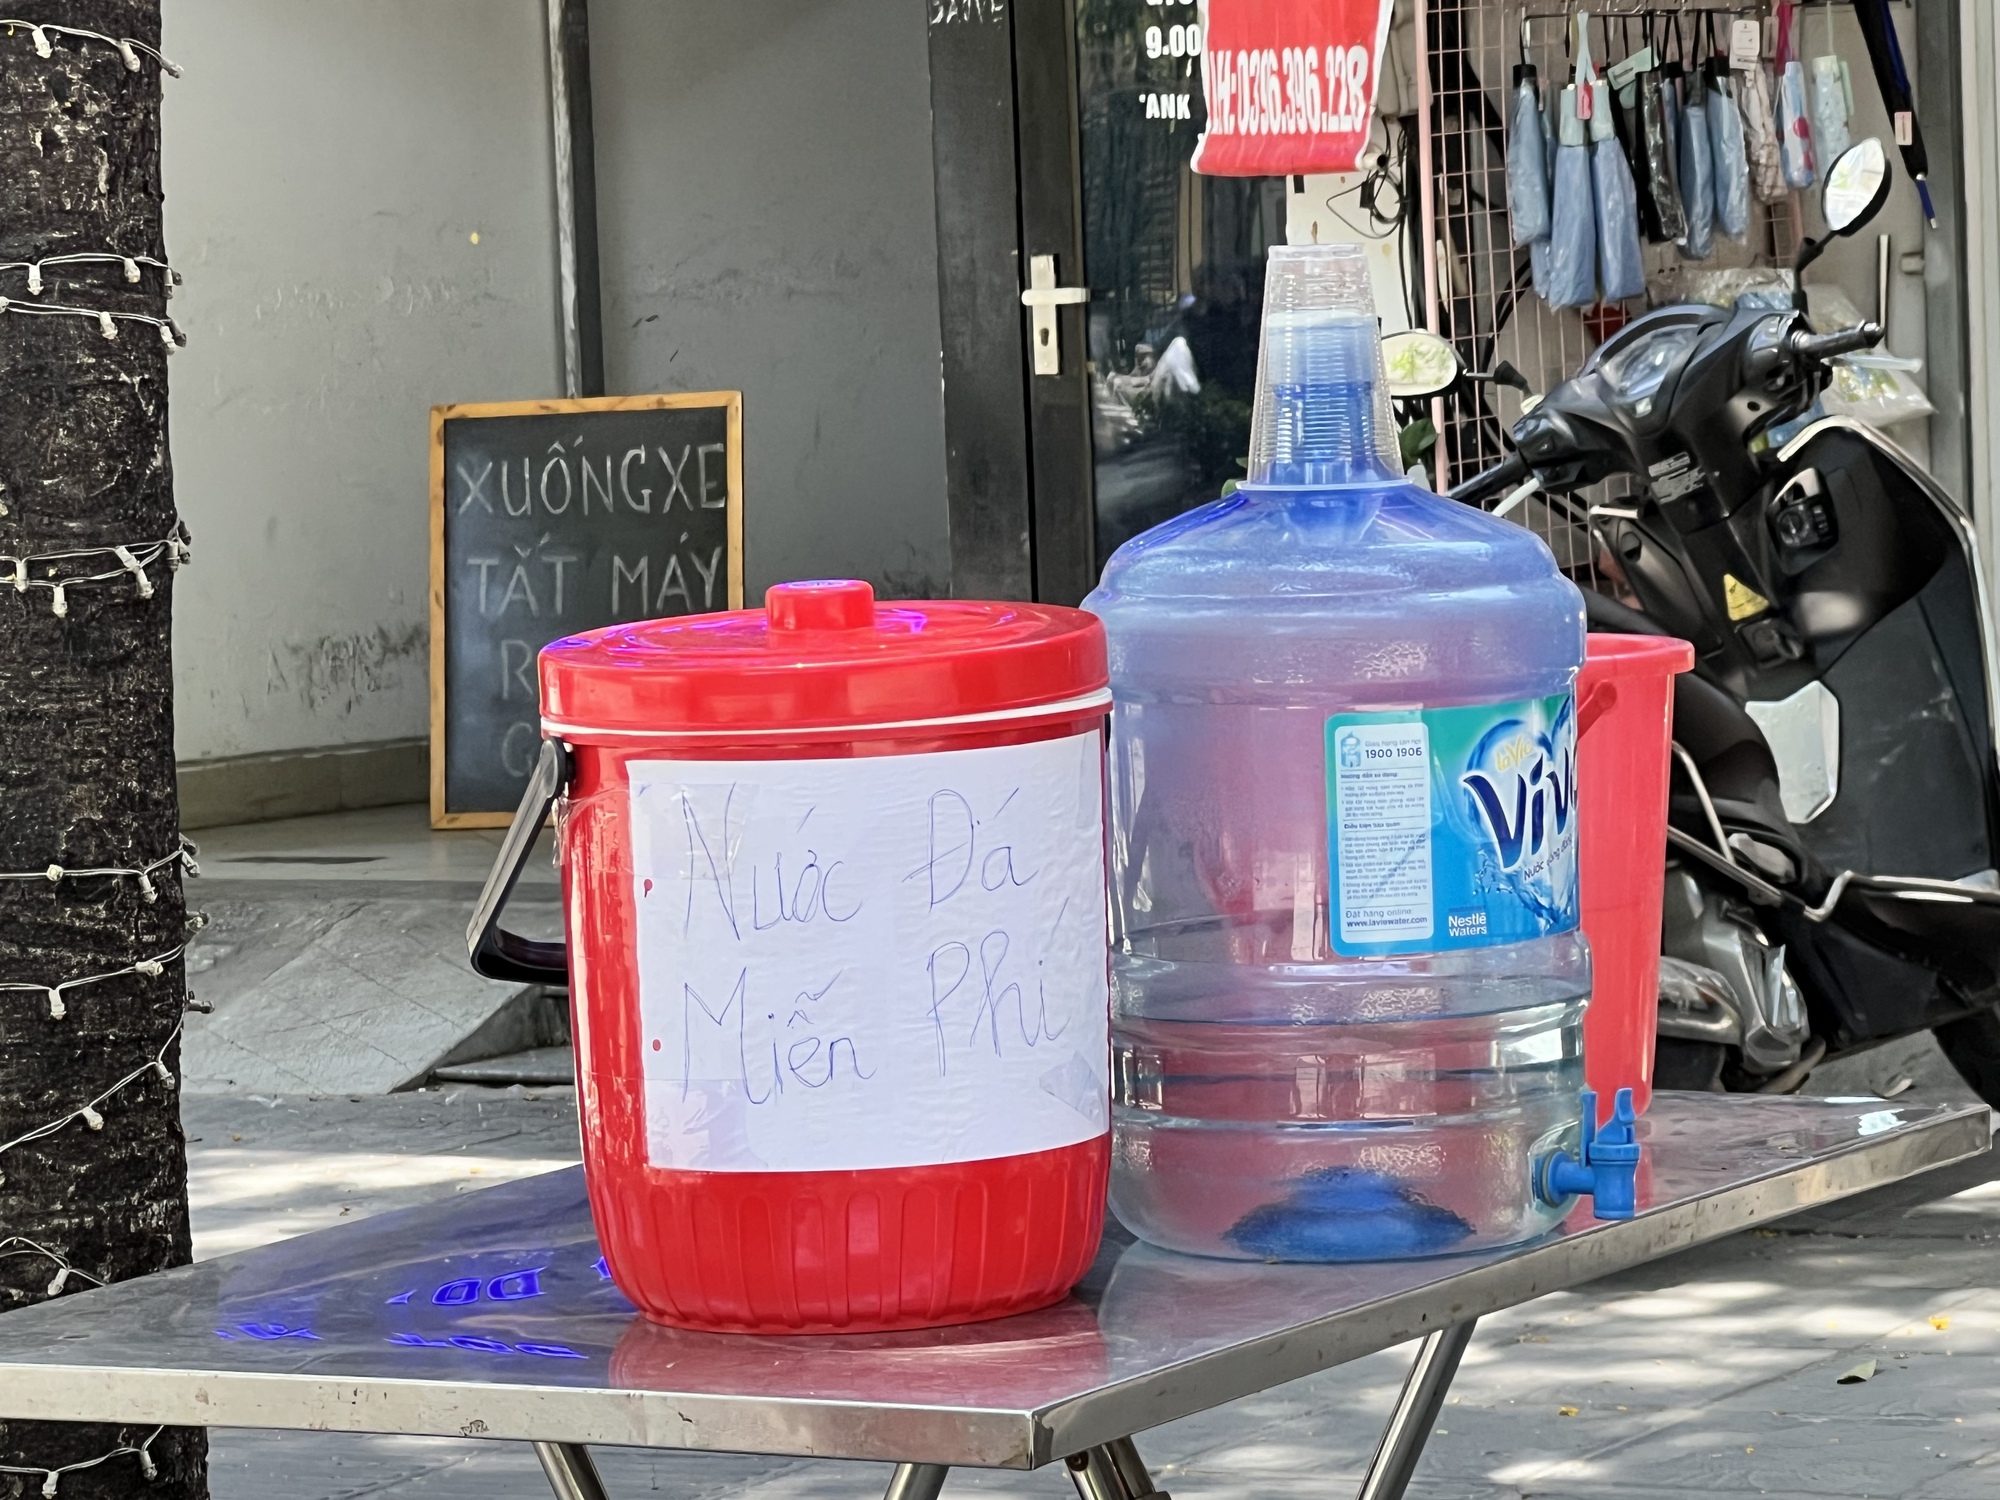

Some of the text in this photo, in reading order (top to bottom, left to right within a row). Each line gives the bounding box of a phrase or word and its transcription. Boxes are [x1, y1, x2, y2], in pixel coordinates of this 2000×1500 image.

[466, 531, 723, 618] TẮT MÁY
[1365, 746, 1423, 759] 1900 1906
[682, 781, 1040, 941] Nước Đá
[1448, 926, 1488, 937] Waters
[682, 896, 1072, 1105] Miễn Phí
